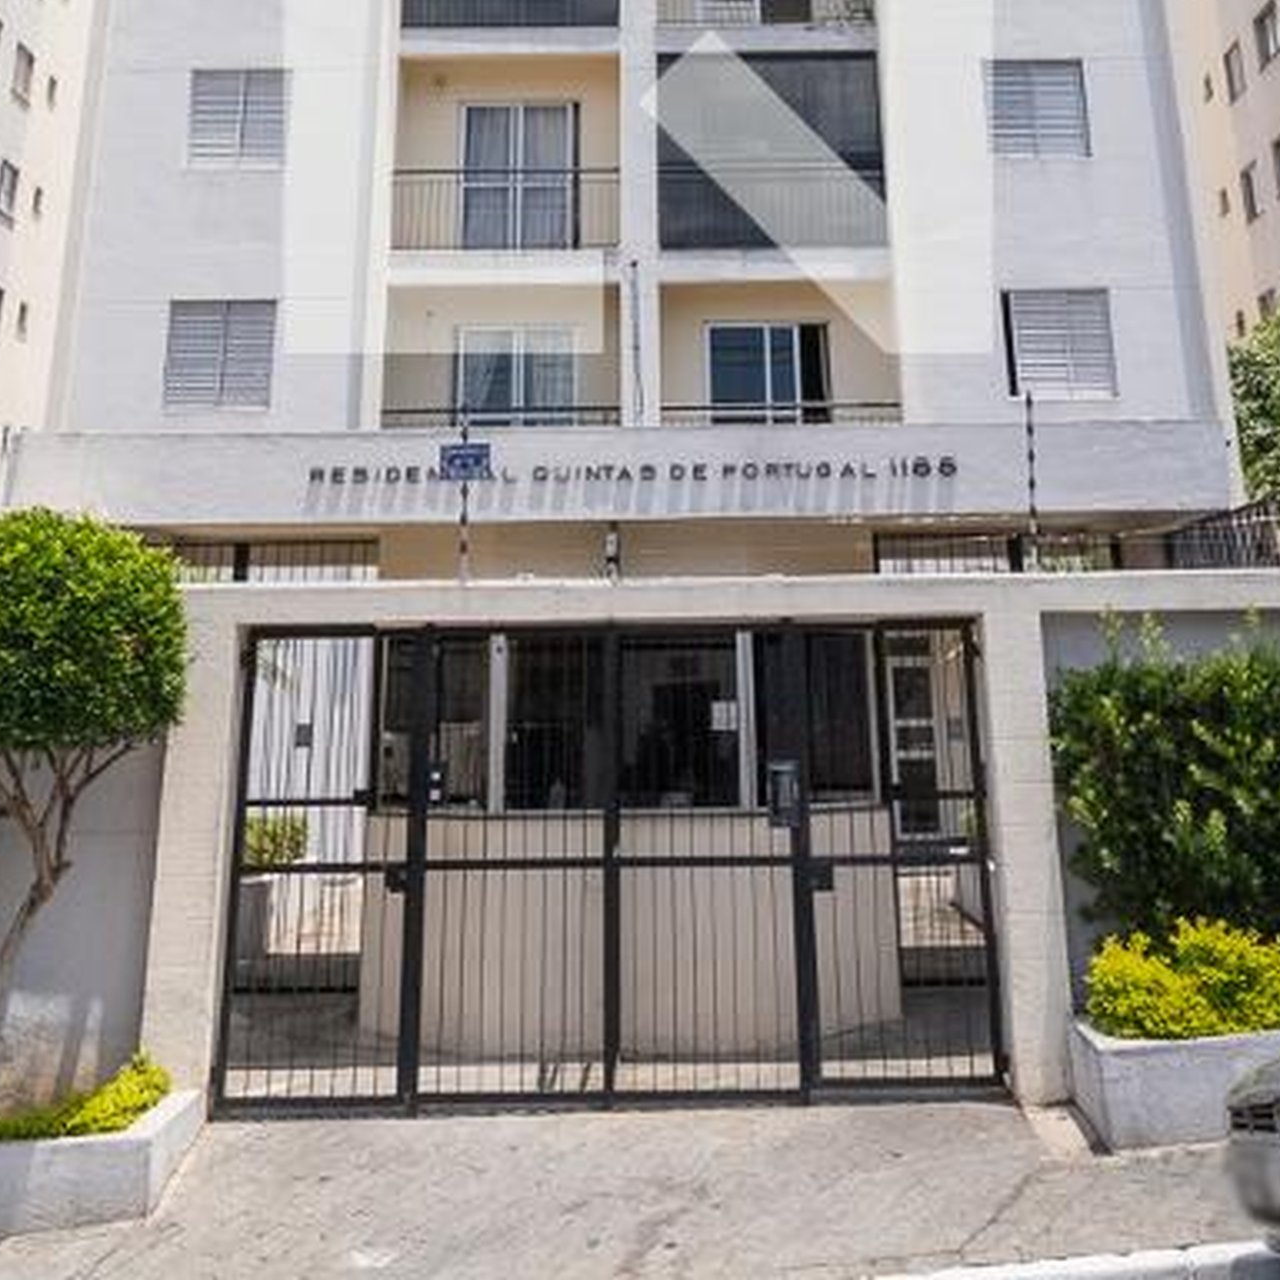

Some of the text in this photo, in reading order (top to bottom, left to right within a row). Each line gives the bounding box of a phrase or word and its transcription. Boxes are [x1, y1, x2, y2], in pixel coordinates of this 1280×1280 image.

[532, 465, 657, 481] QUINTAS
[669, 463, 708, 481] DE
[722, 461, 876, 480] PORTUGAL
